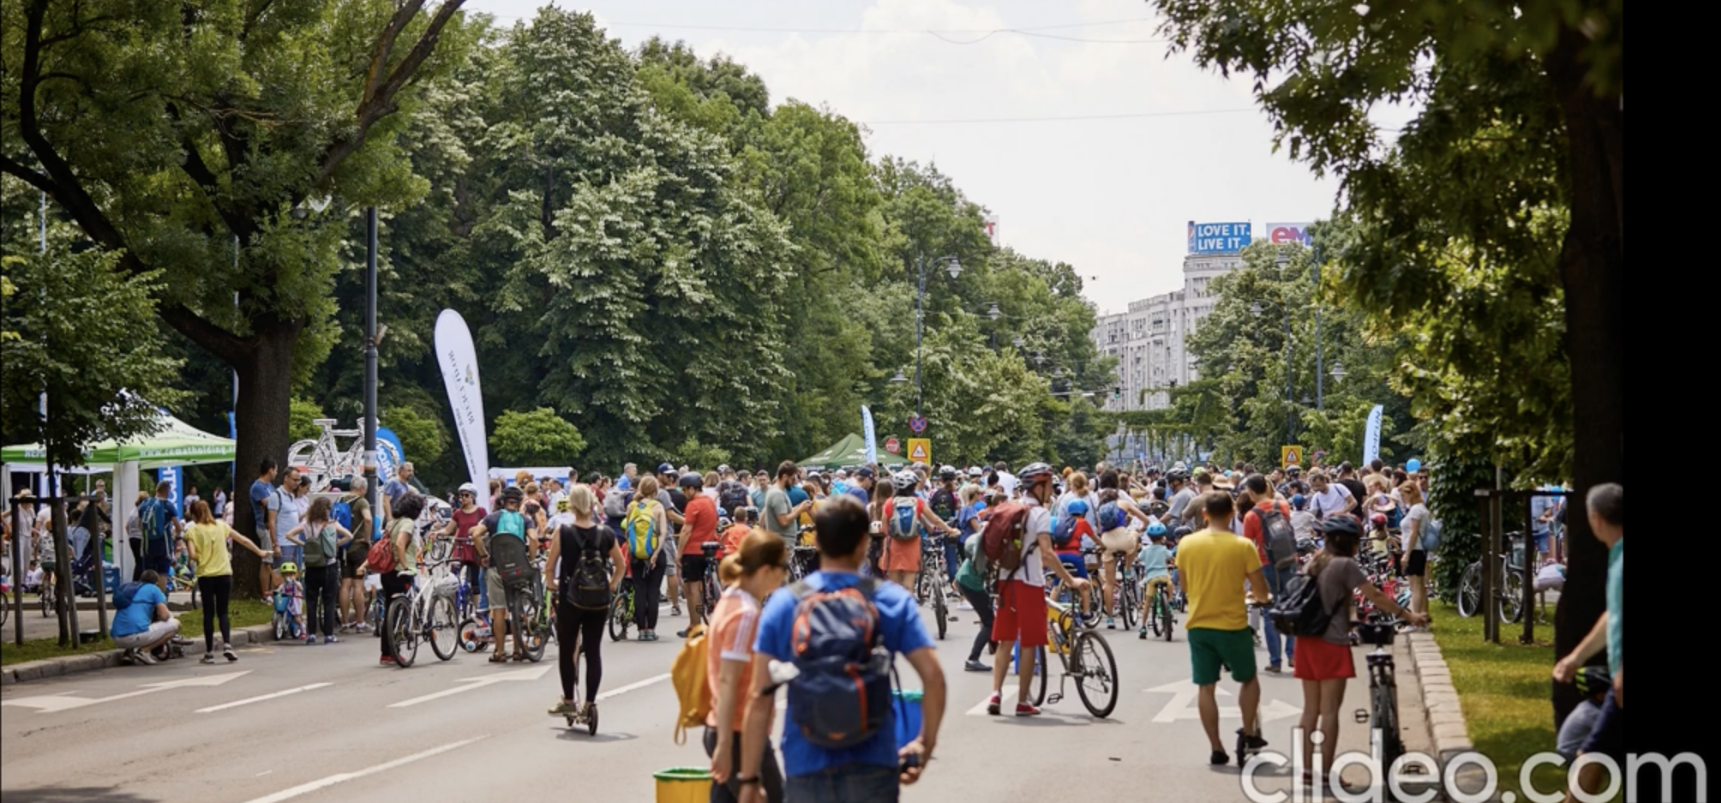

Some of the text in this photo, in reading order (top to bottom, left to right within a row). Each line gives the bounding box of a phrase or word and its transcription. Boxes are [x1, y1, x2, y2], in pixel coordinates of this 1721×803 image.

[1198, 224, 1229, 237] LOVE
[1233, 223, 1250, 236] IT.
[1198, 238, 1225, 250] LIVE
